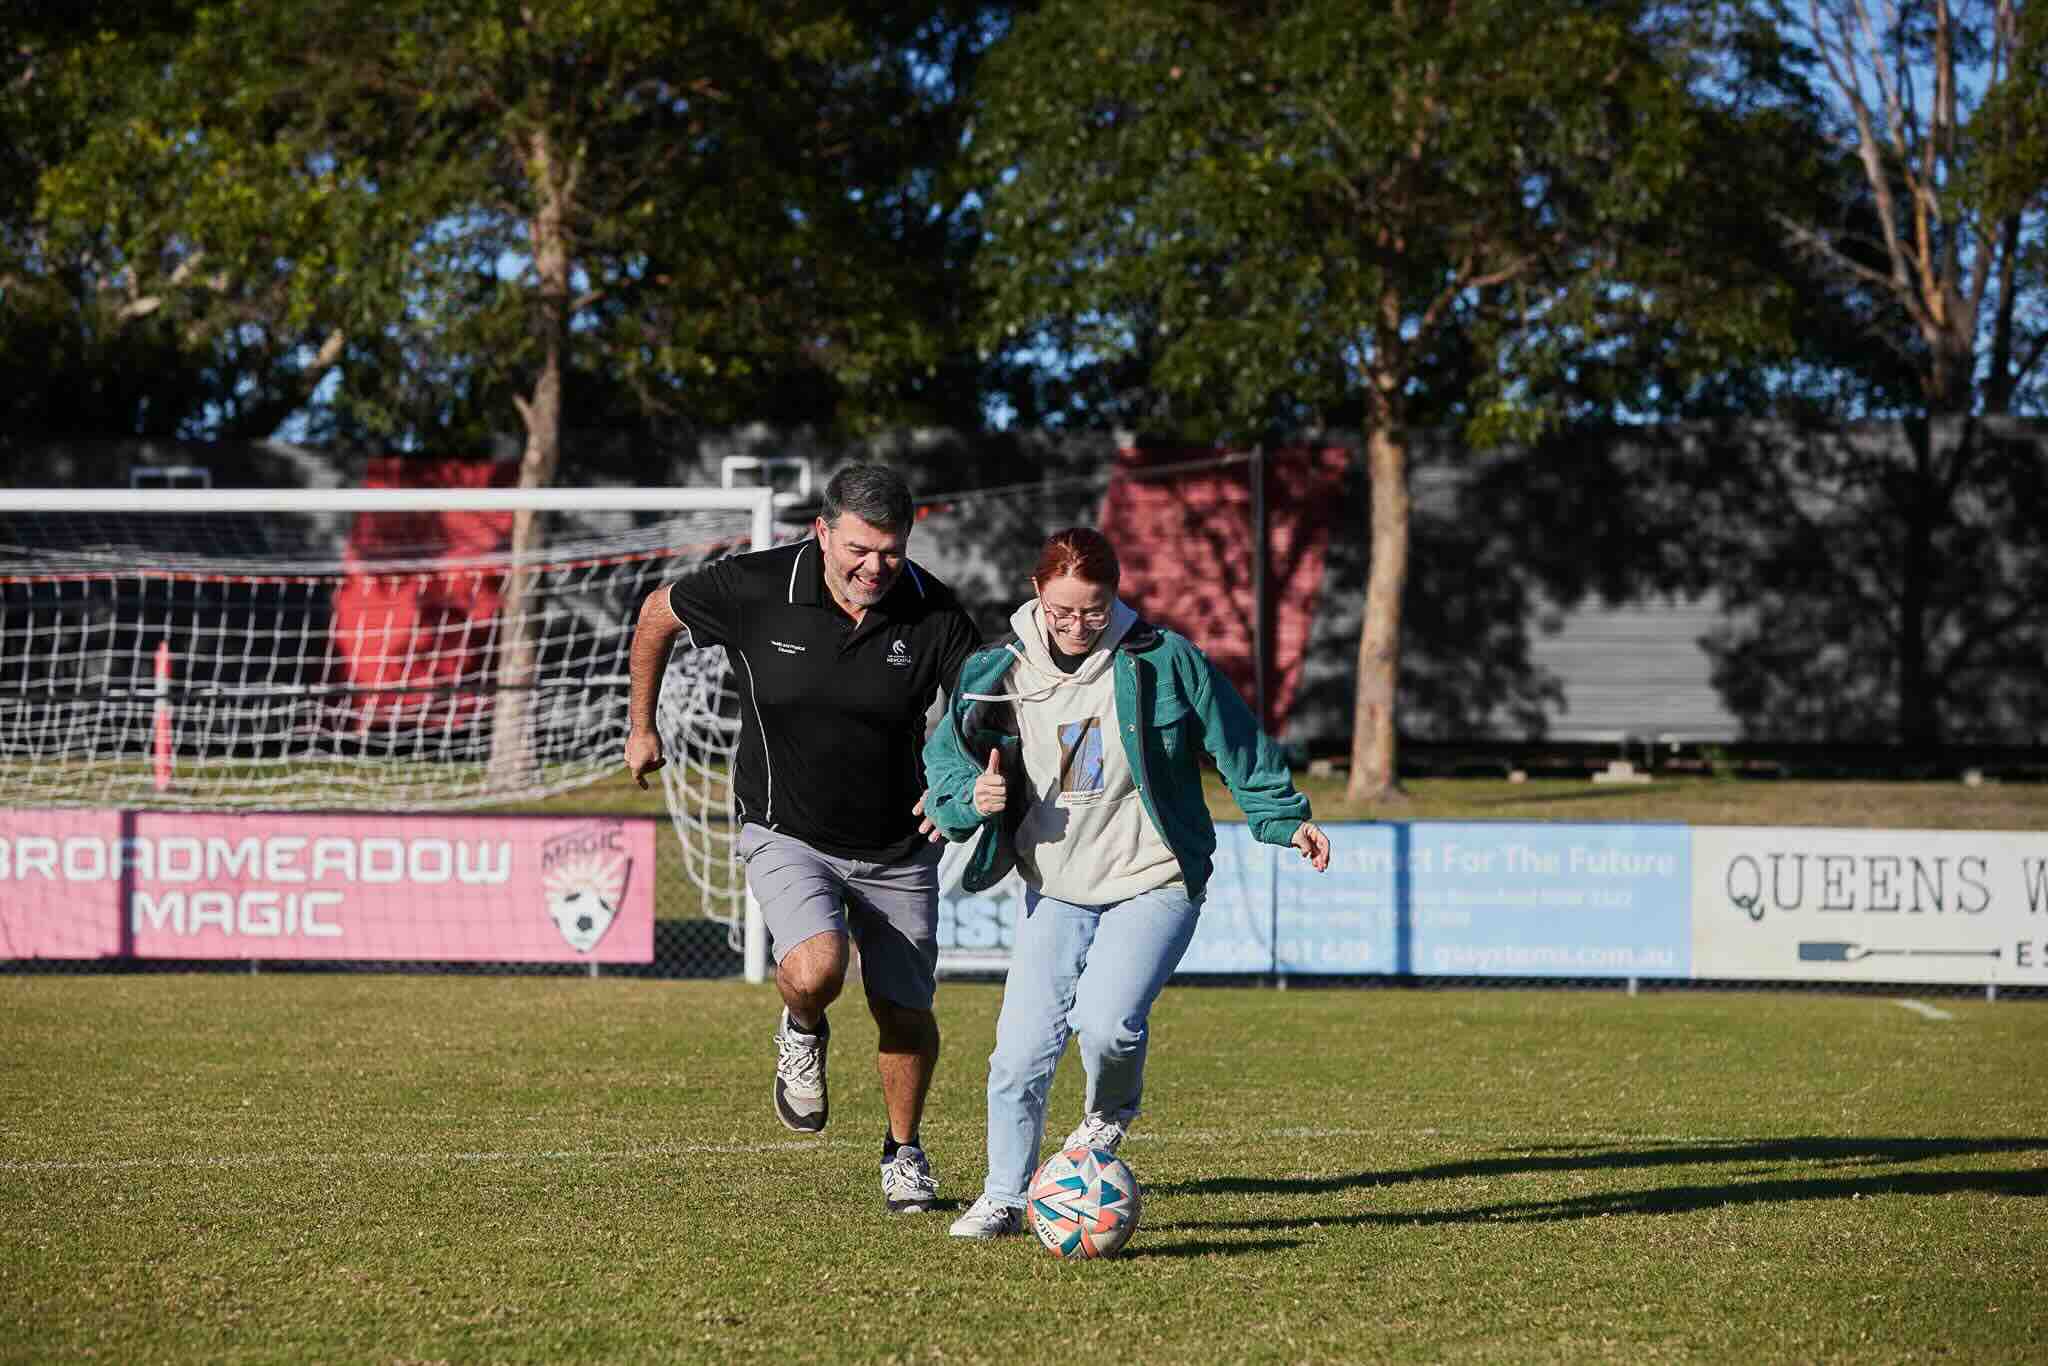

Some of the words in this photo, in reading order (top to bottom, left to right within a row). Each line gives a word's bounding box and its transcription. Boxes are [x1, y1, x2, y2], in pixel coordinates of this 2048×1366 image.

[0, 836, 511, 883] ROADMEADOW
[1442, 845, 1495, 874] For
[1505, 845, 1560, 874] The
[1726, 854, 1991, 921] QUEENS
[132, 891, 343, 936] MAGIC
